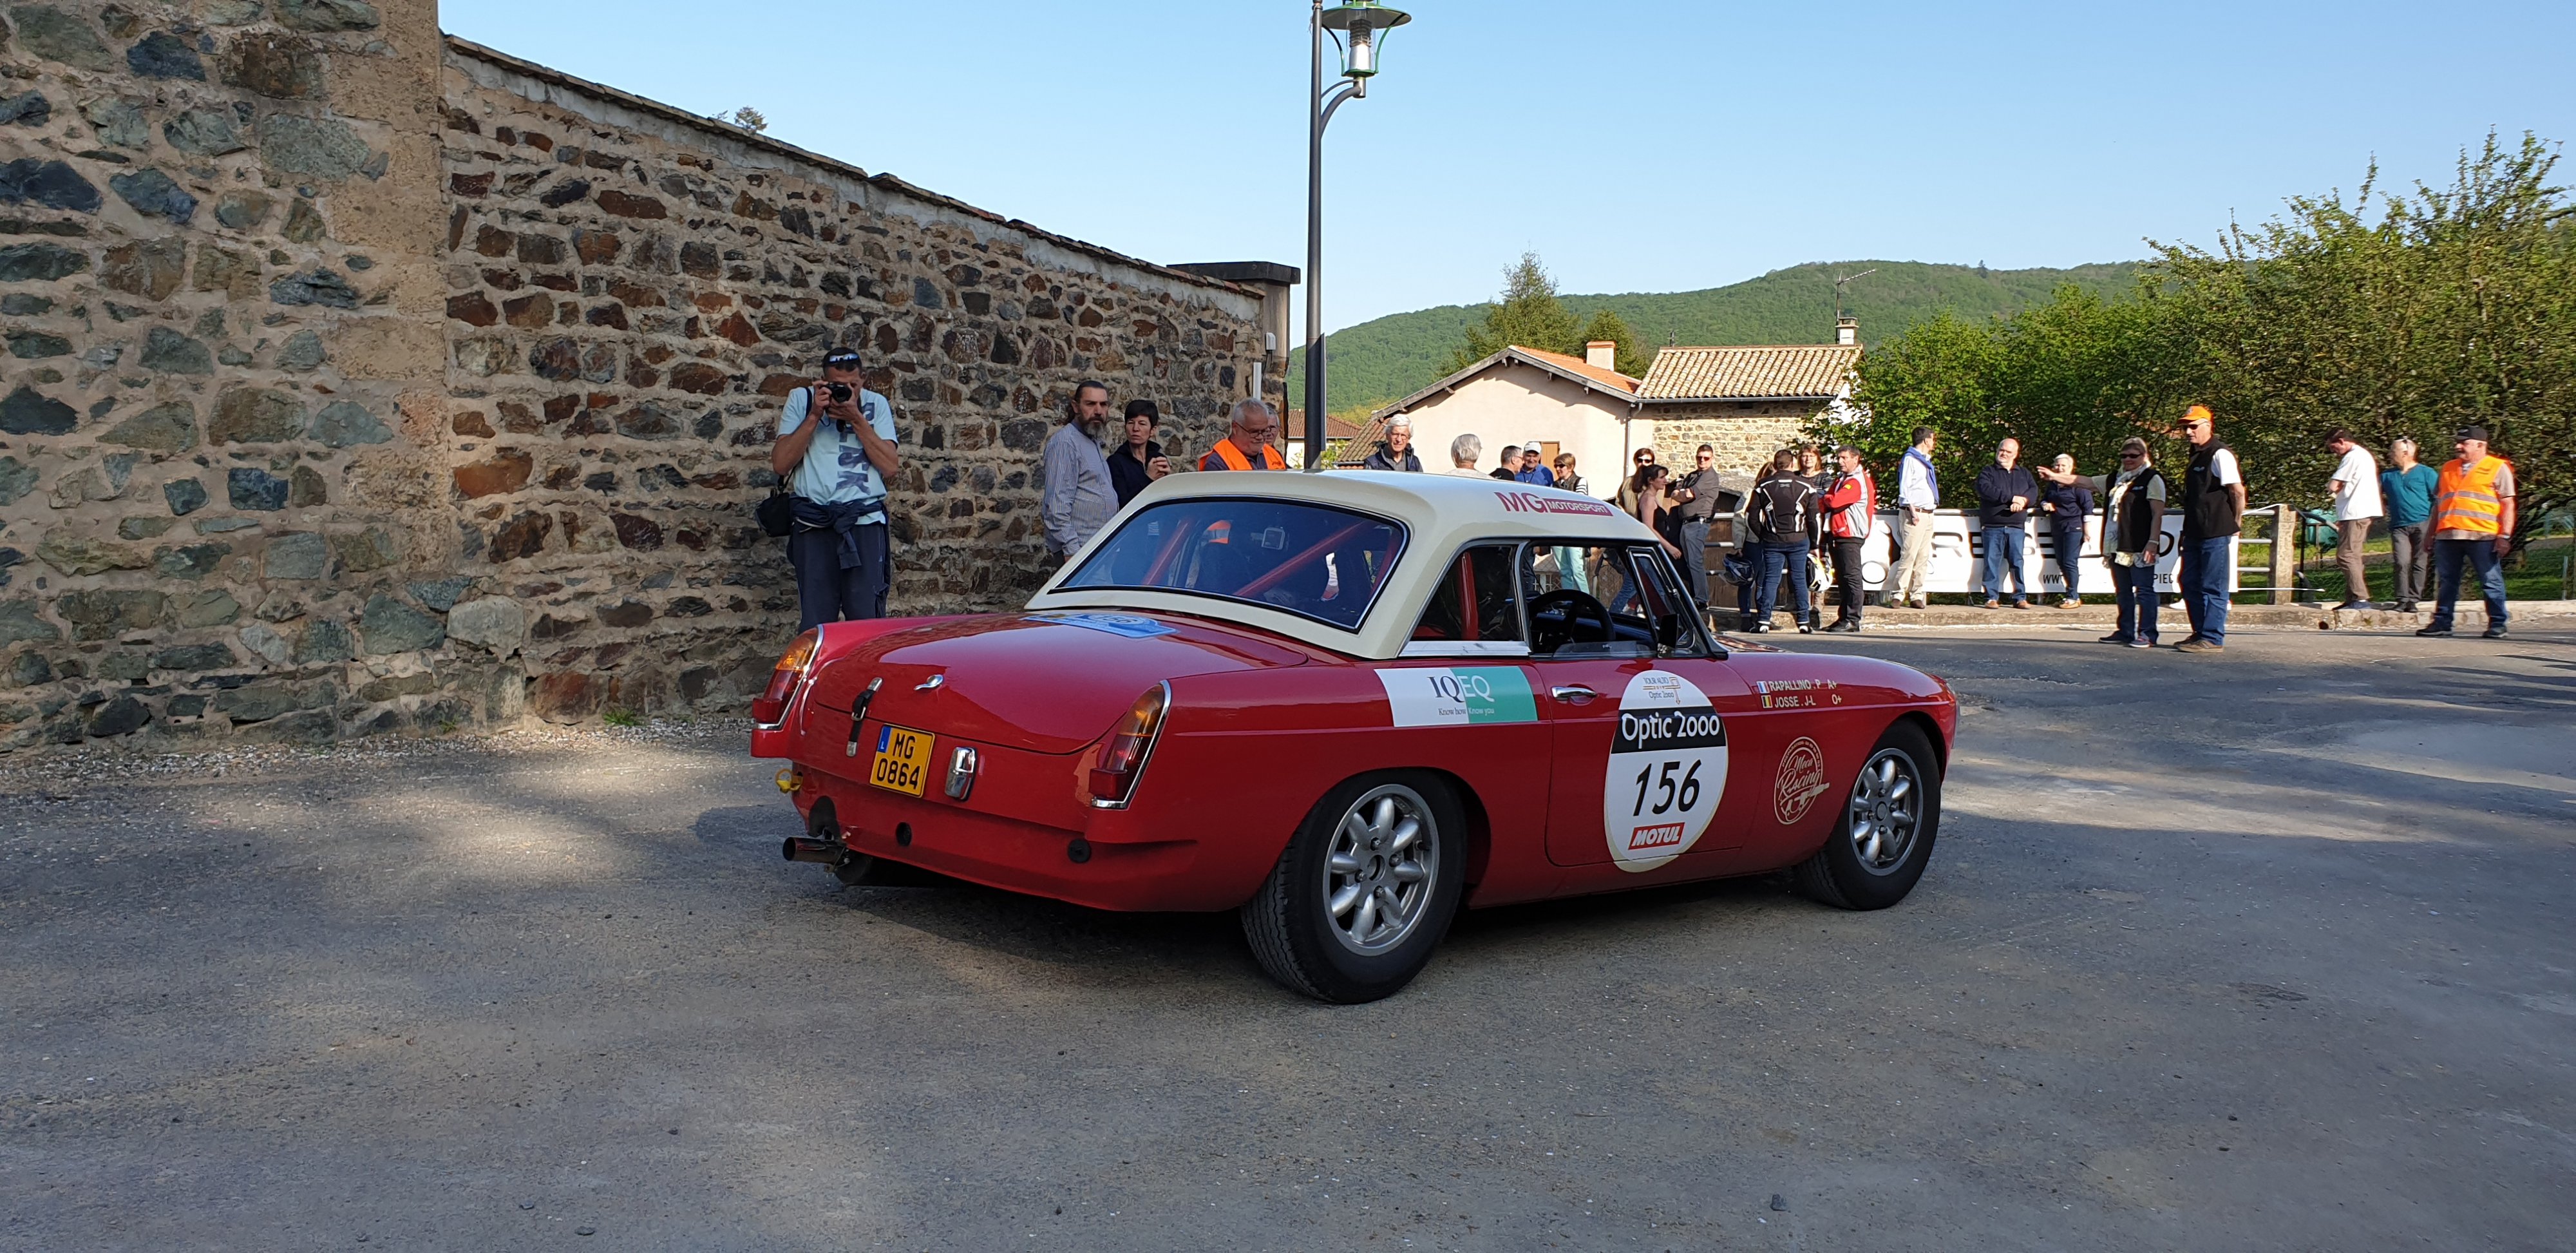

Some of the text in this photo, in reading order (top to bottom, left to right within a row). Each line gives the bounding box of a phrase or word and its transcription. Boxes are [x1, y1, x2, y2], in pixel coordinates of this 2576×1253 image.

[1494, 492, 1608, 513] MG MOTORSPORT
[1768, 680, 1811, 691] RAPALLINO
[1827, 679, 1837, 689] A+
[1484, 707, 1494, 716] you
[1622, 711, 1720, 749] Optic 2000
[880, 741, 884, 749] L
[892, 732, 916, 759] MG
[876, 758, 920, 790] 0864
[1777, 769, 1821, 800] Racing
[1633, 759, 1702, 816] 156
[1631, 825, 1681, 846] MOTUL
